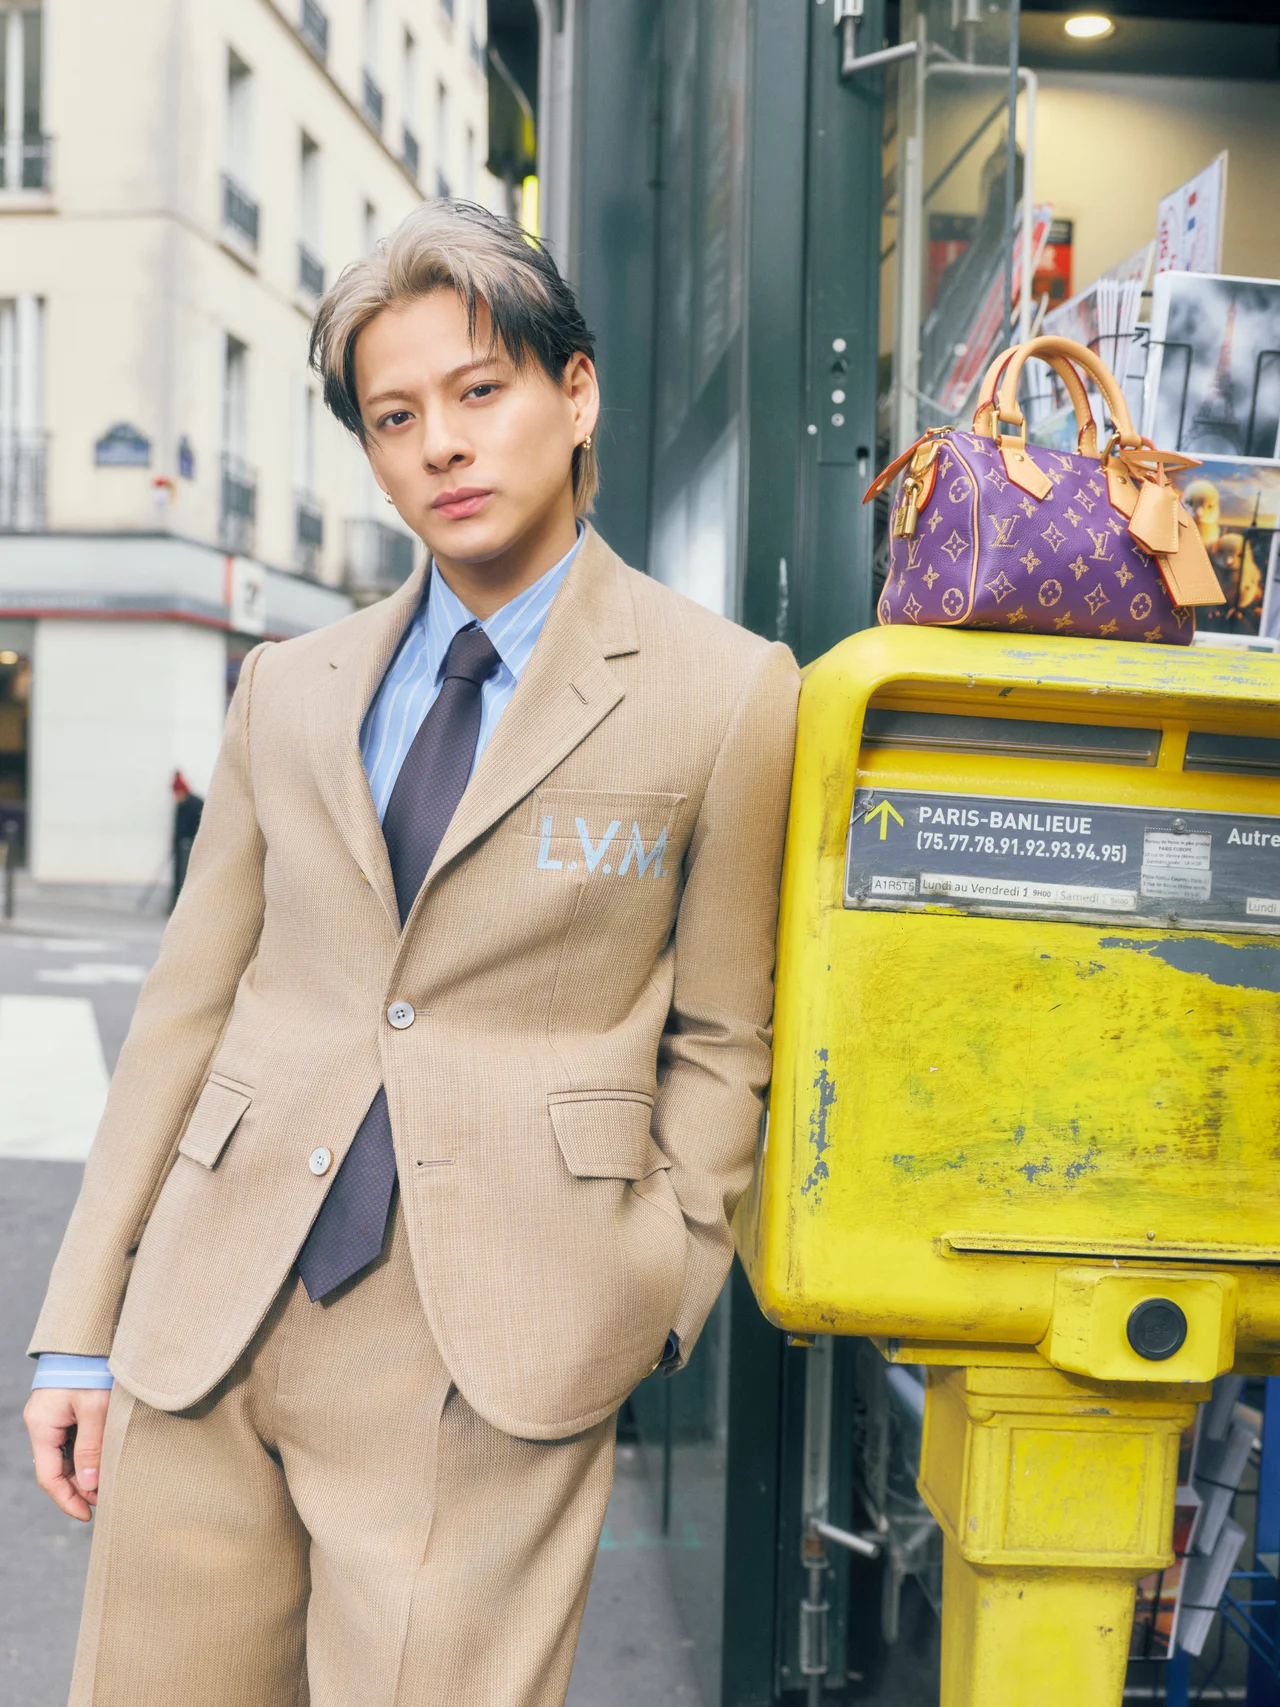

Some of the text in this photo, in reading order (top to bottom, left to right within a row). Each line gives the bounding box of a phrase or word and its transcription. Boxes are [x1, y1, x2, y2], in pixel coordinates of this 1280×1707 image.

[919, 806, 1093, 835] PARIS-BANLIEUE
[536, 815, 669, 880] L.V.M.
[916, 830, 1128, 864] (75.77.78.91.92.93.94.95)
[922, 879, 952, 891] Lundi
[954, 882, 968, 892] au
[971, 883, 1020, 897] Vendredi
[1060, 890, 1099, 903] Samedi
[1248, 902, 1277, 913] Lundi
